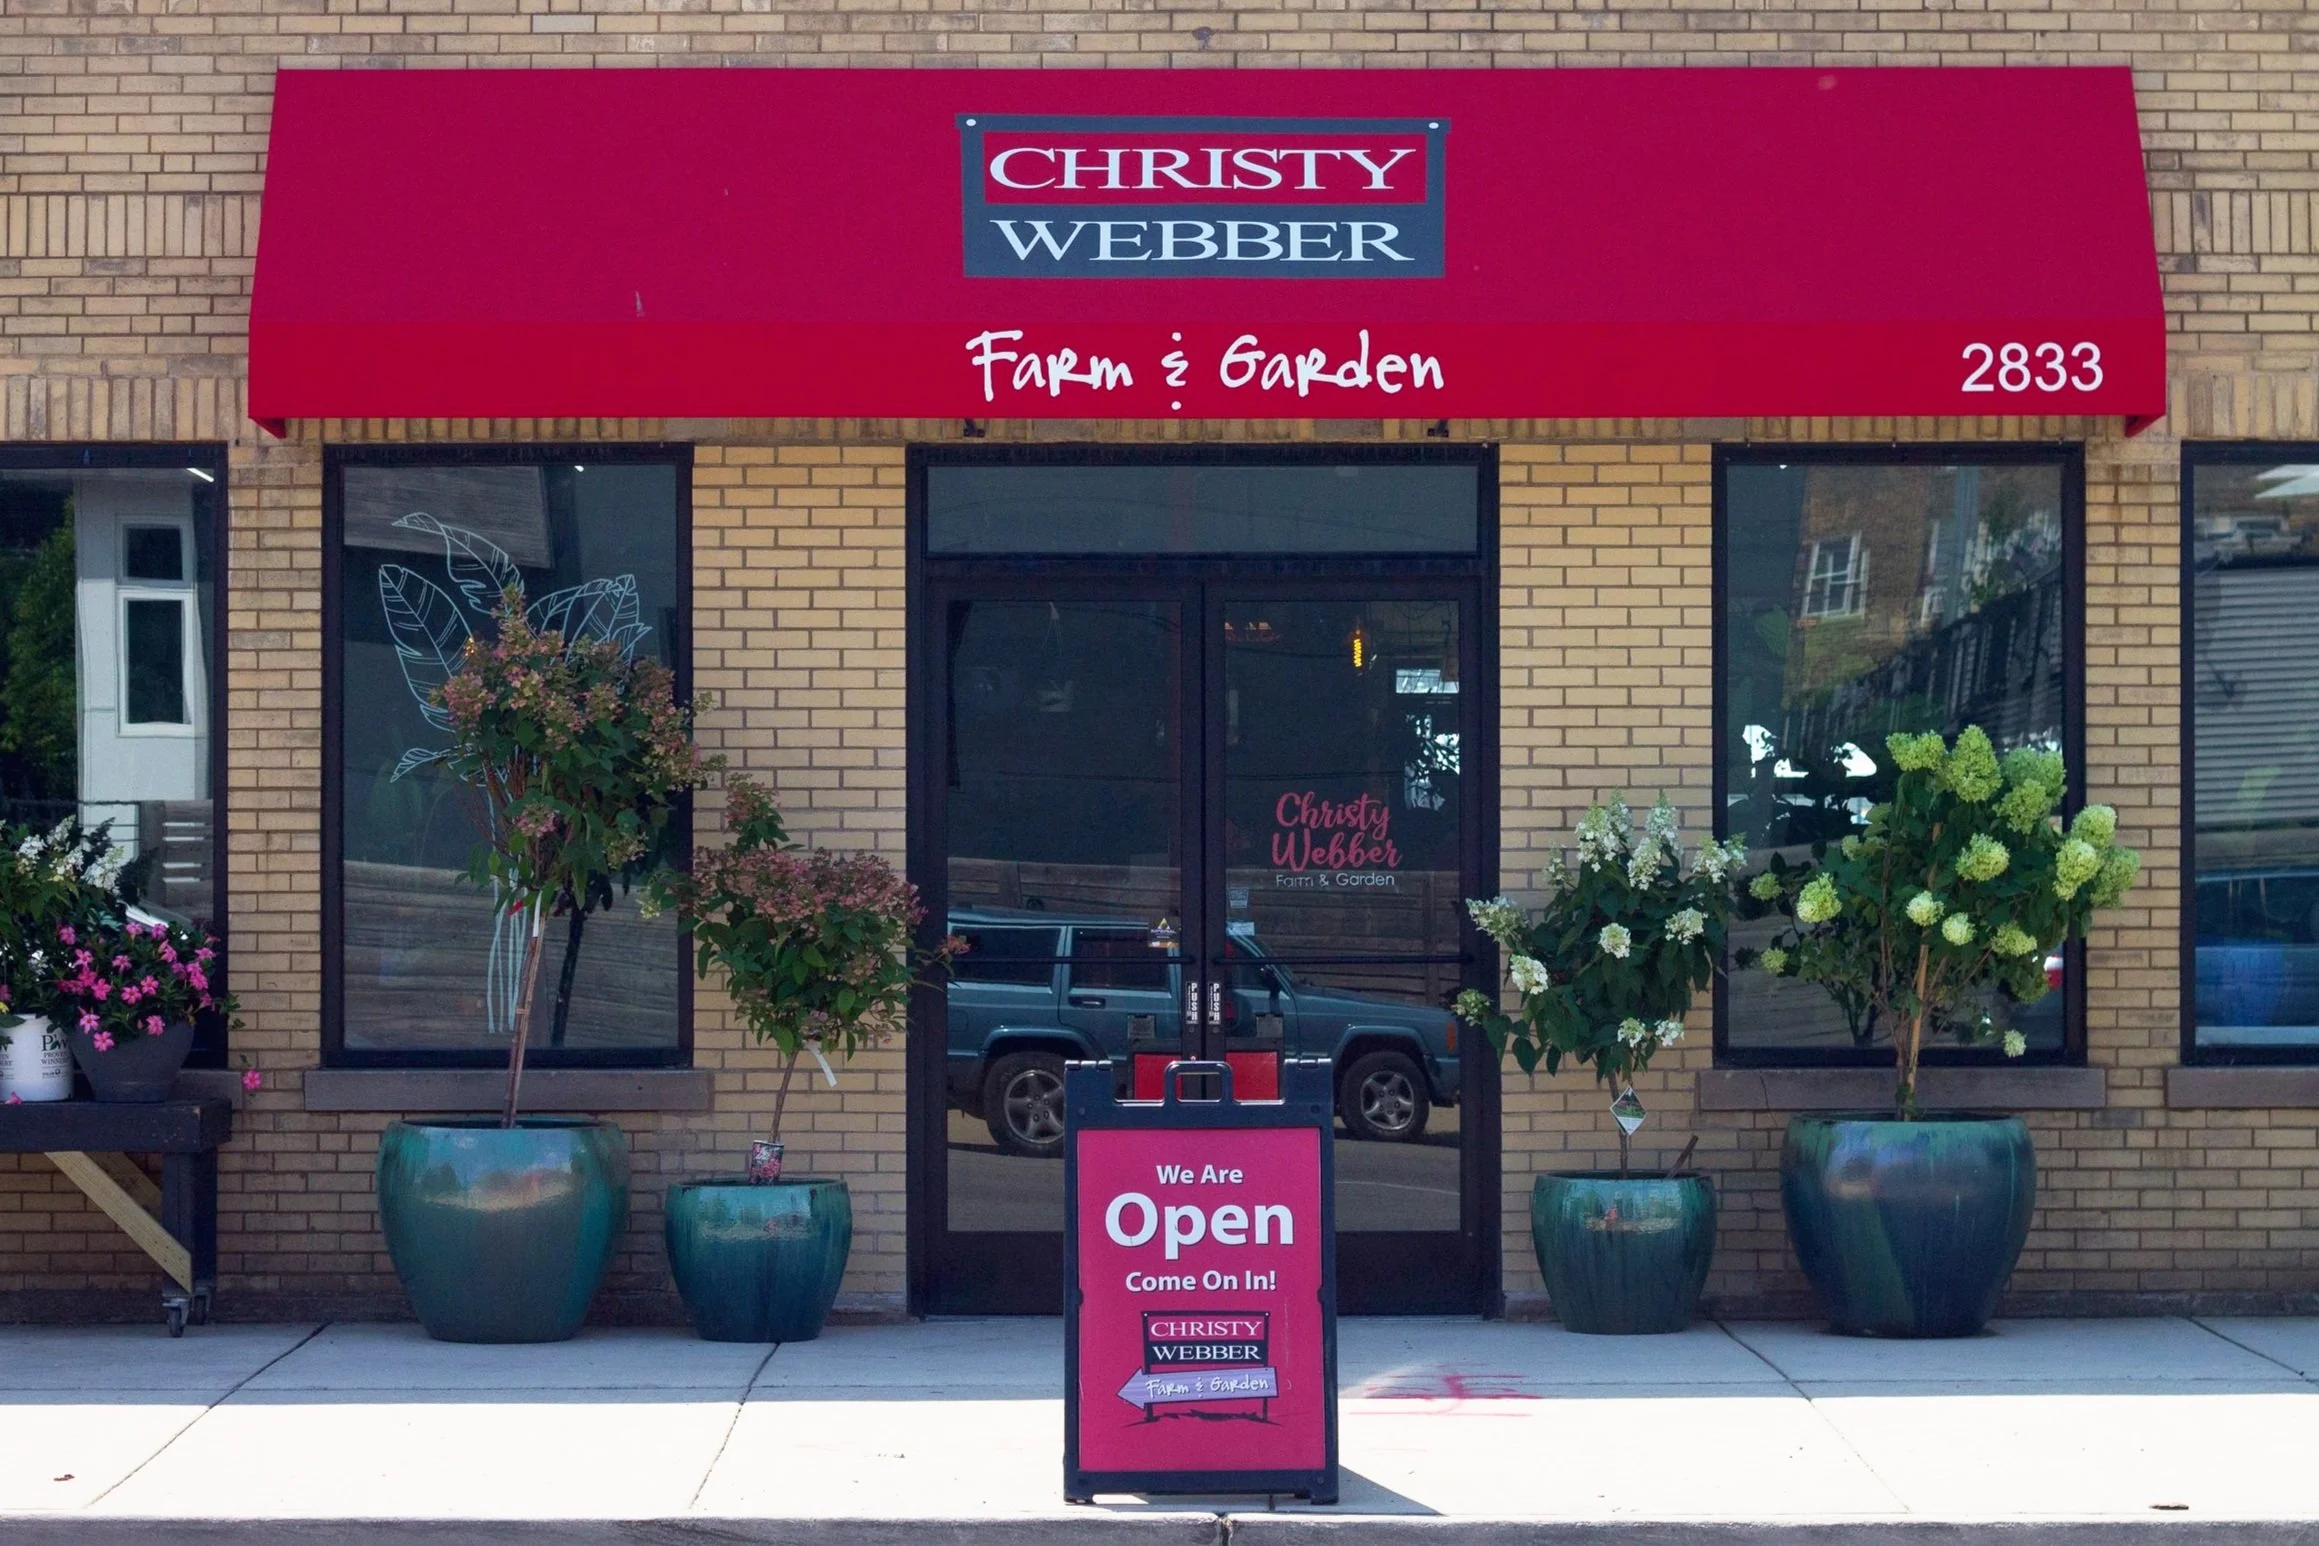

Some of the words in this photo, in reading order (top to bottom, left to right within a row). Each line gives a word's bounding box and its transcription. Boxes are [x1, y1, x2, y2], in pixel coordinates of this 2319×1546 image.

[989, 147, 1416, 190] CHRISTY
[989, 219, 1416, 262] WEBBER
[1161, 332, 1189, 411] &
[1961, 341, 2104, 392] 2833
[1275, 790, 1391, 841] Christy
[1271, 828, 1402, 873] Webber
[1276, 874, 1314, 888] Farm
[1319, 873, 1330, 888] &
[1336, 871, 1395, 887] Garden
[1156, 1164, 1195, 1185] We
[1200, 1164, 1244, 1185] Are
[1105, 1192, 1295, 1260] Open
[1125, 1271, 1197, 1293] Come
[1202, 1270, 1239, 1292] On
[1245, 1270, 1277, 1291] In!
[1150, 1321, 1262, 1338] CHRISTY
[1152, 1345, 1262, 1361] WEBBER
